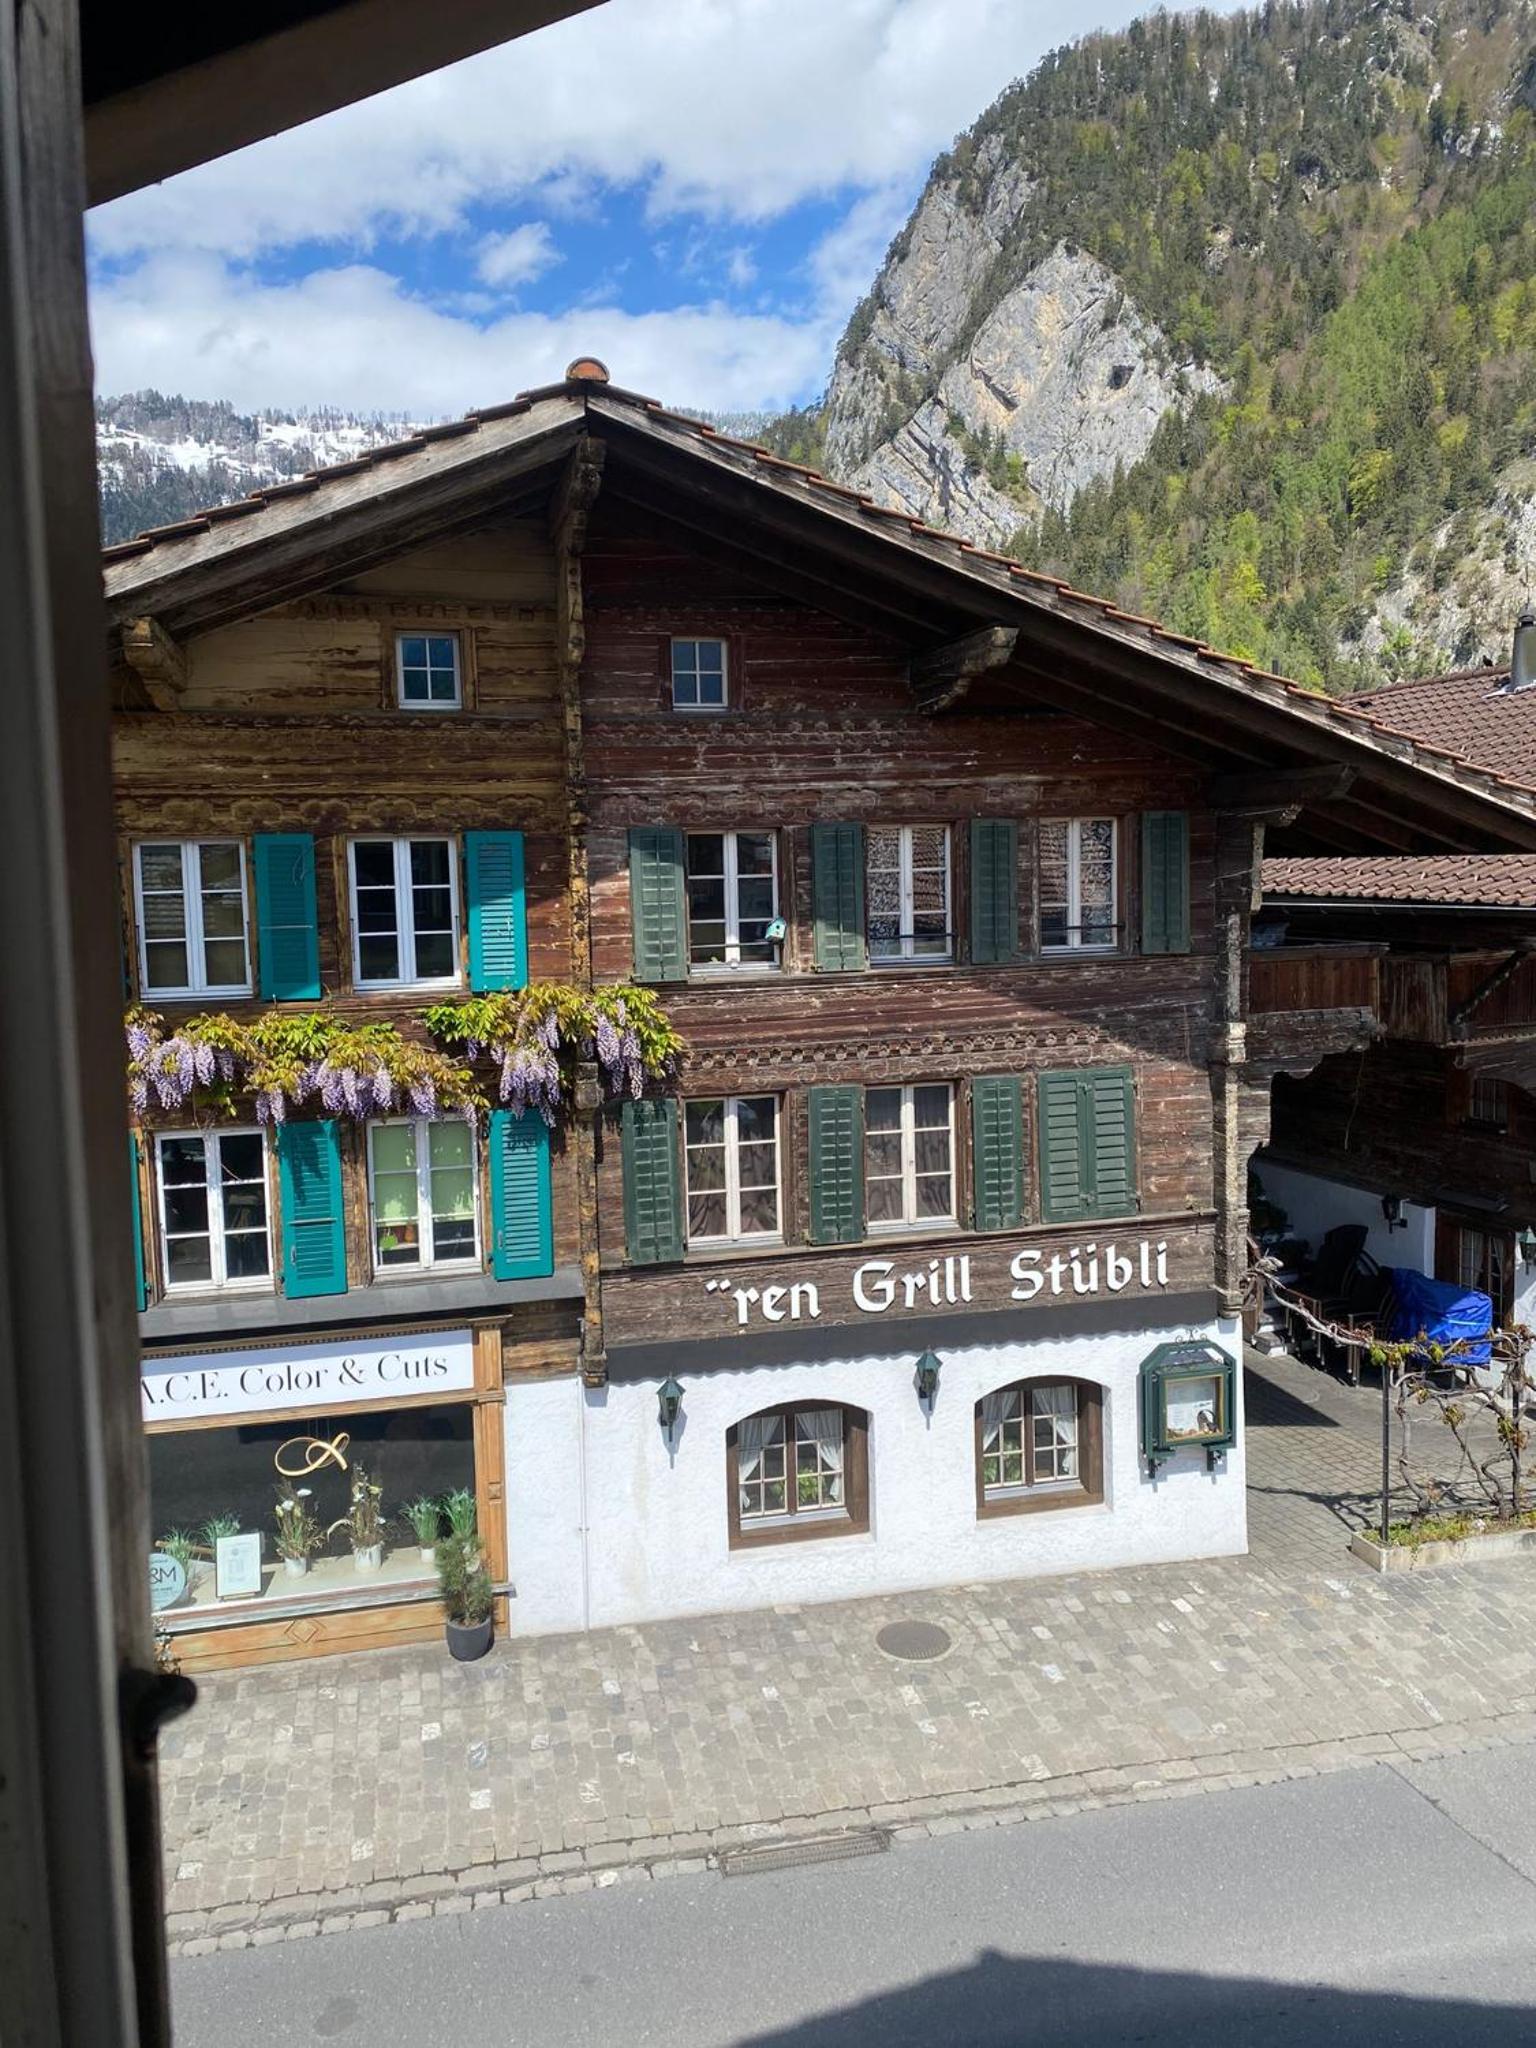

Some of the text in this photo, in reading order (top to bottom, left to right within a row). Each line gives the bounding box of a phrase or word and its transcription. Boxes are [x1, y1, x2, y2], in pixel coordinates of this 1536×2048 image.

[852, 1254, 974, 1313] Grill
[1010, 1240, 1170, 1301] Stübli
[239, 1364, 329, 1395] Color
[338, 1357, 365, 1385] &
[377, 1353, 448, 1382] Cuts
